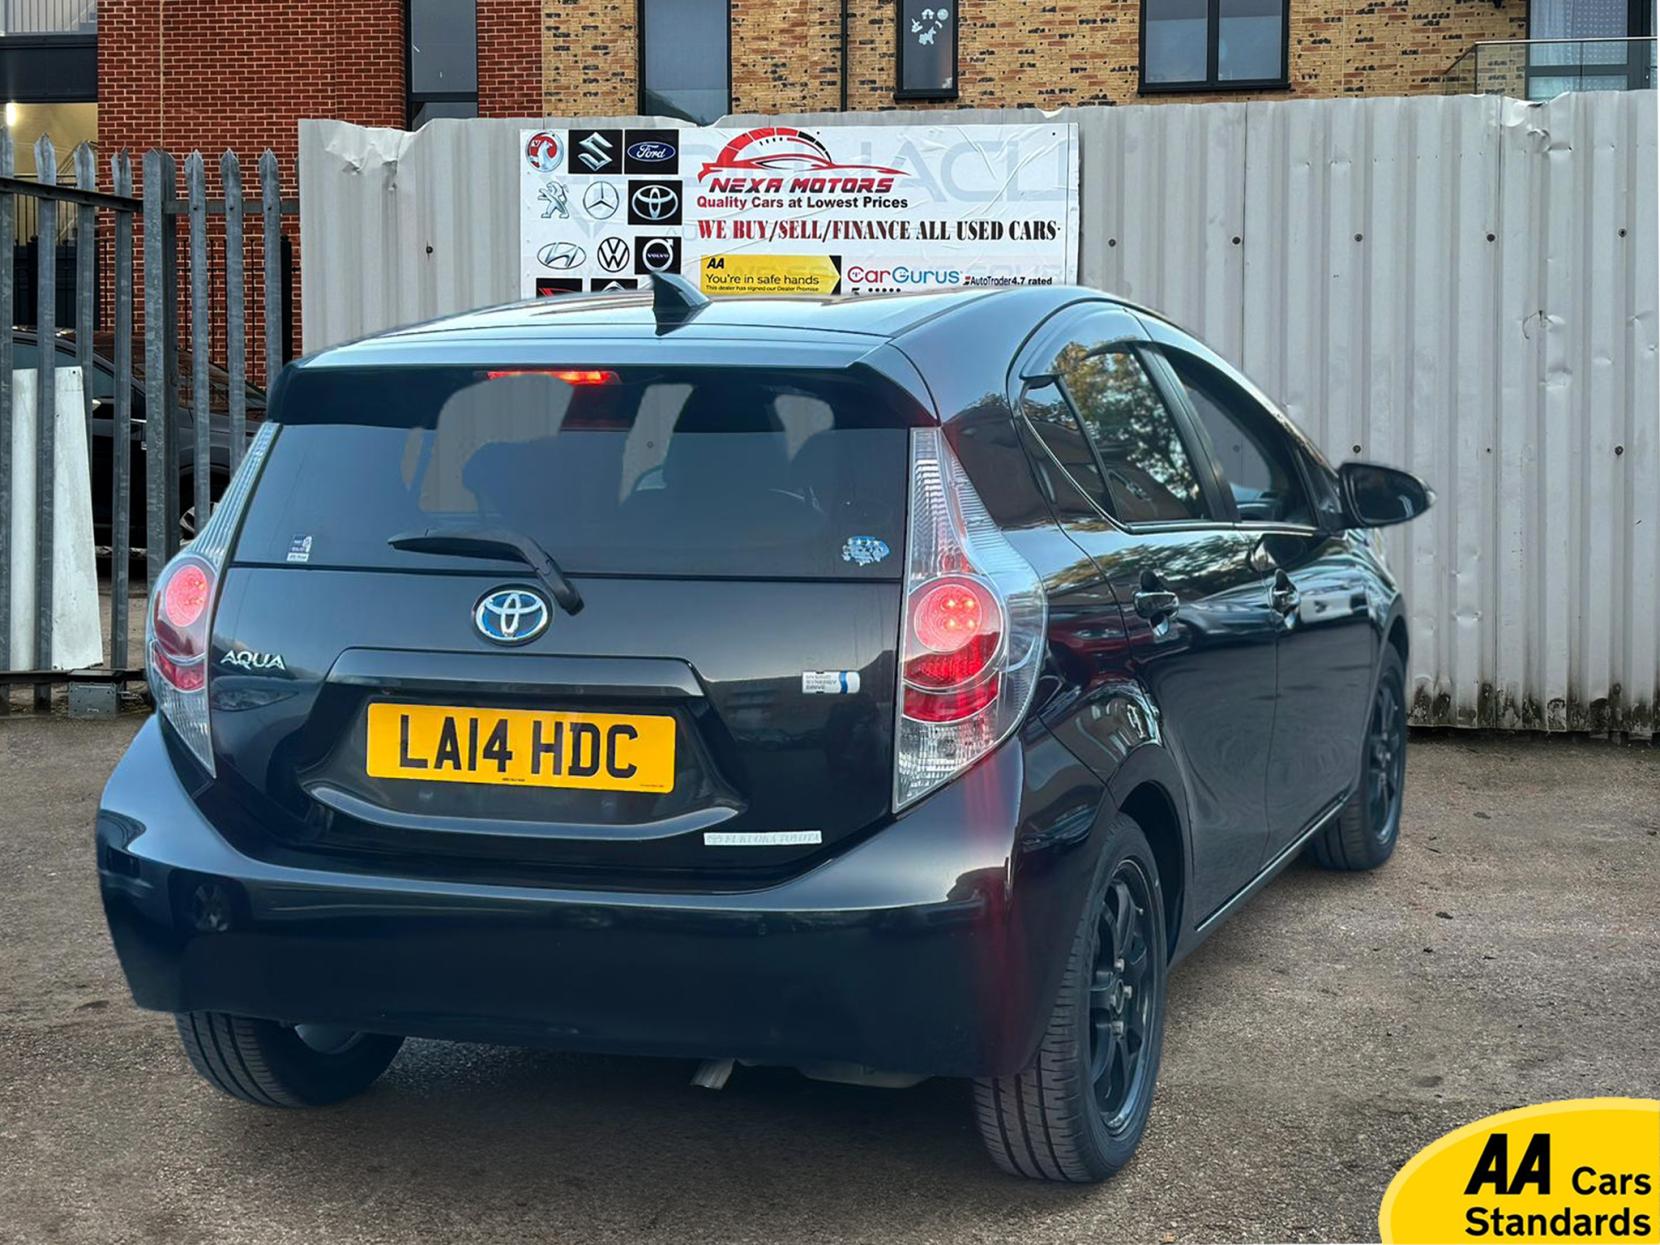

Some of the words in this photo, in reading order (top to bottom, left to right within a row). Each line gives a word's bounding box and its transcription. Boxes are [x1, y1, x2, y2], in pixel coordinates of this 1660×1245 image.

[636, 144, 666, 159] Ford
[709, 178, 783, 194] NEXA
[789, 178, 895, 194] MOTORS
[697, 196, 747, 210] Quality
[752, 196, 784, 209] Cars
[788, 197, 803, 209] at
[807, 196, 859, 209] Lowest
[863, 196, 909, 209] Prices
[697, 220, 727, 240] WE
[916, 220, 951, 241] ALL
[956, 220, 1004, 241] USED
[1008, 220, 1057, 241] CARS
[706, 257, 725, 269] AA
[705, 273, 741, 284] You're
[744, 273, 754, 284] in
[757, 273, 781, 285] safe
[783, 273, 820, 285] hands
[847, 265, 960, 284] CarGurus
[1028, 276, 1053, 286] rated
[220, 650, 286, 671] AQUA
[399, 714, 513, 773] LA14
[531, 720, 639, 779] HDC
